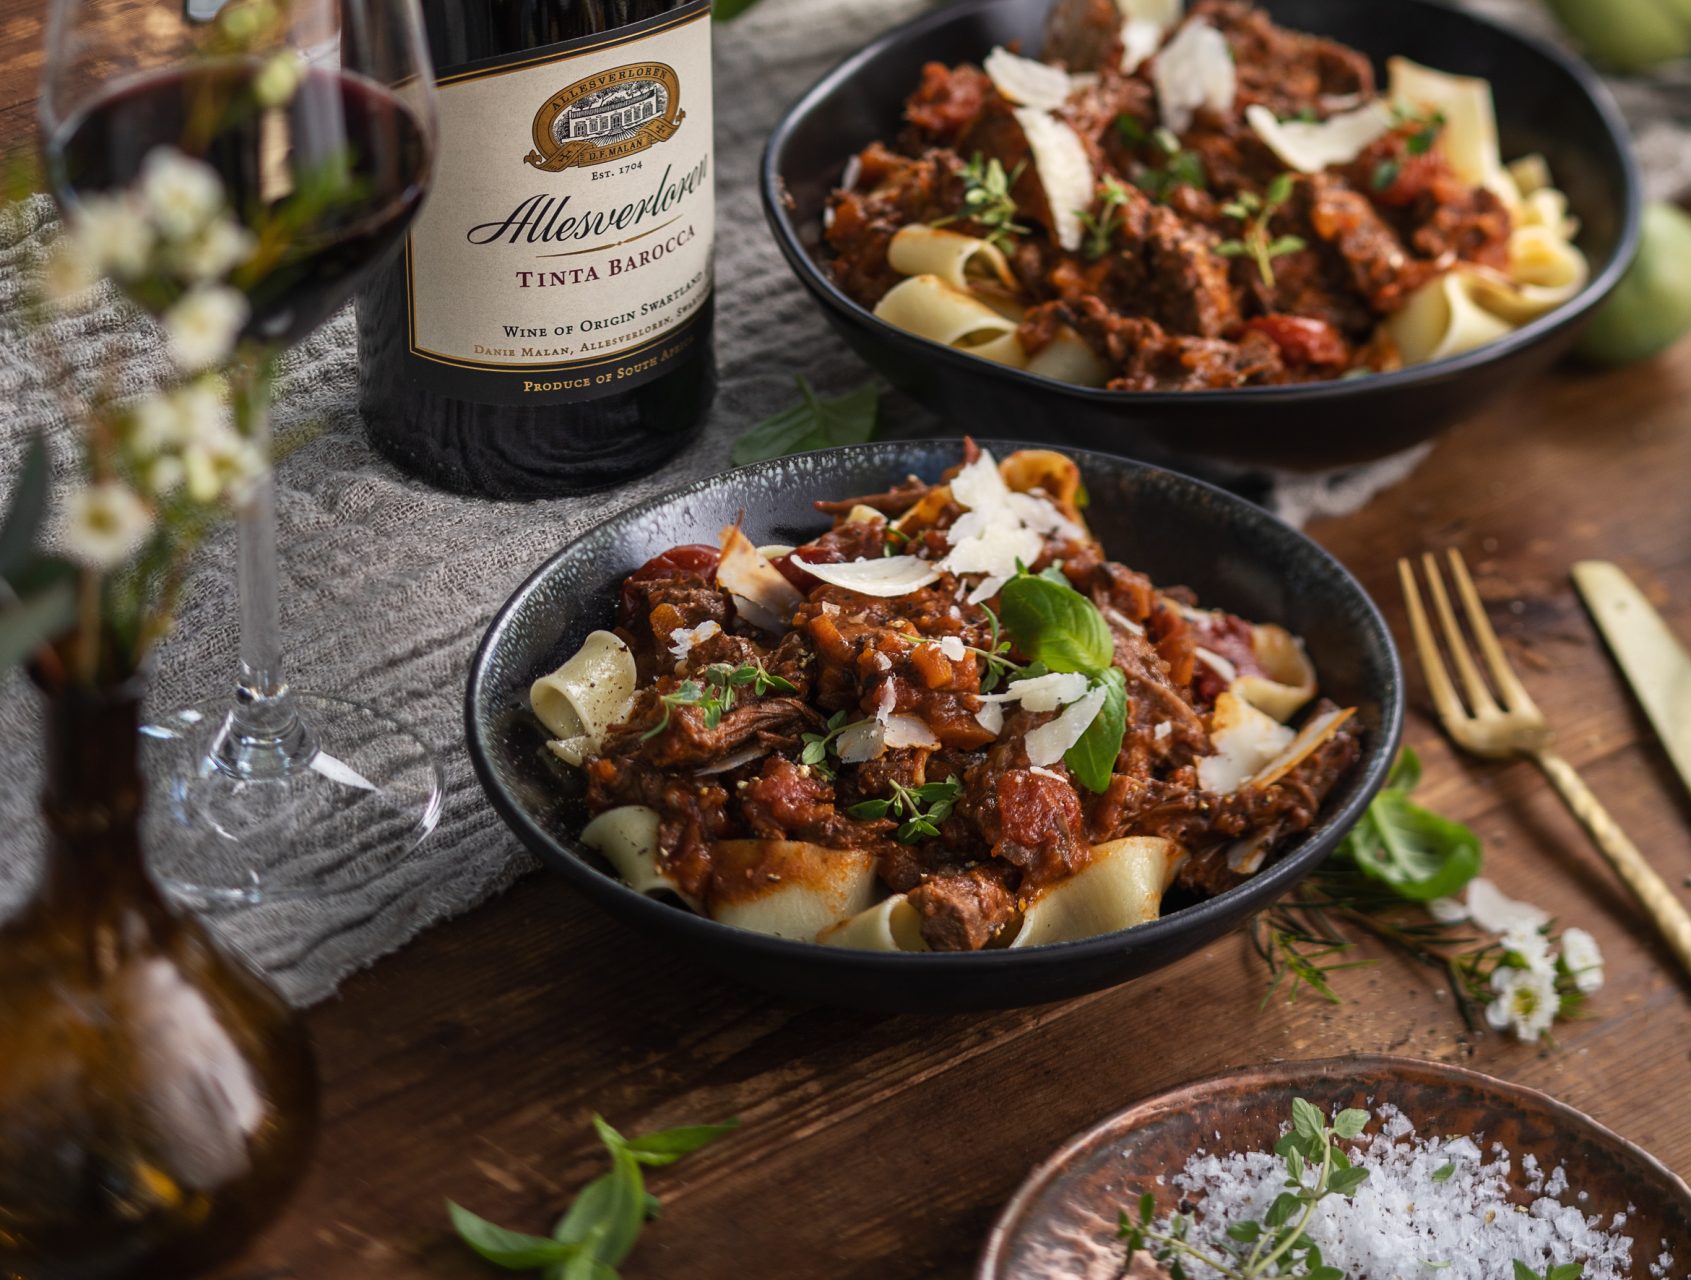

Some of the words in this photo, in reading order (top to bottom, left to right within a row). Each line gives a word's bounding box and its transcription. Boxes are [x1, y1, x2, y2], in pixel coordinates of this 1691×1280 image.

[551, 67, 668, 111] ALLESVERLOREN
[619, 161, 643, 175] 1704
[467, 153, 708, 245] Allesverloren
[554, 325, 573, 336] OF
[596, 373, 613, 385] OF
